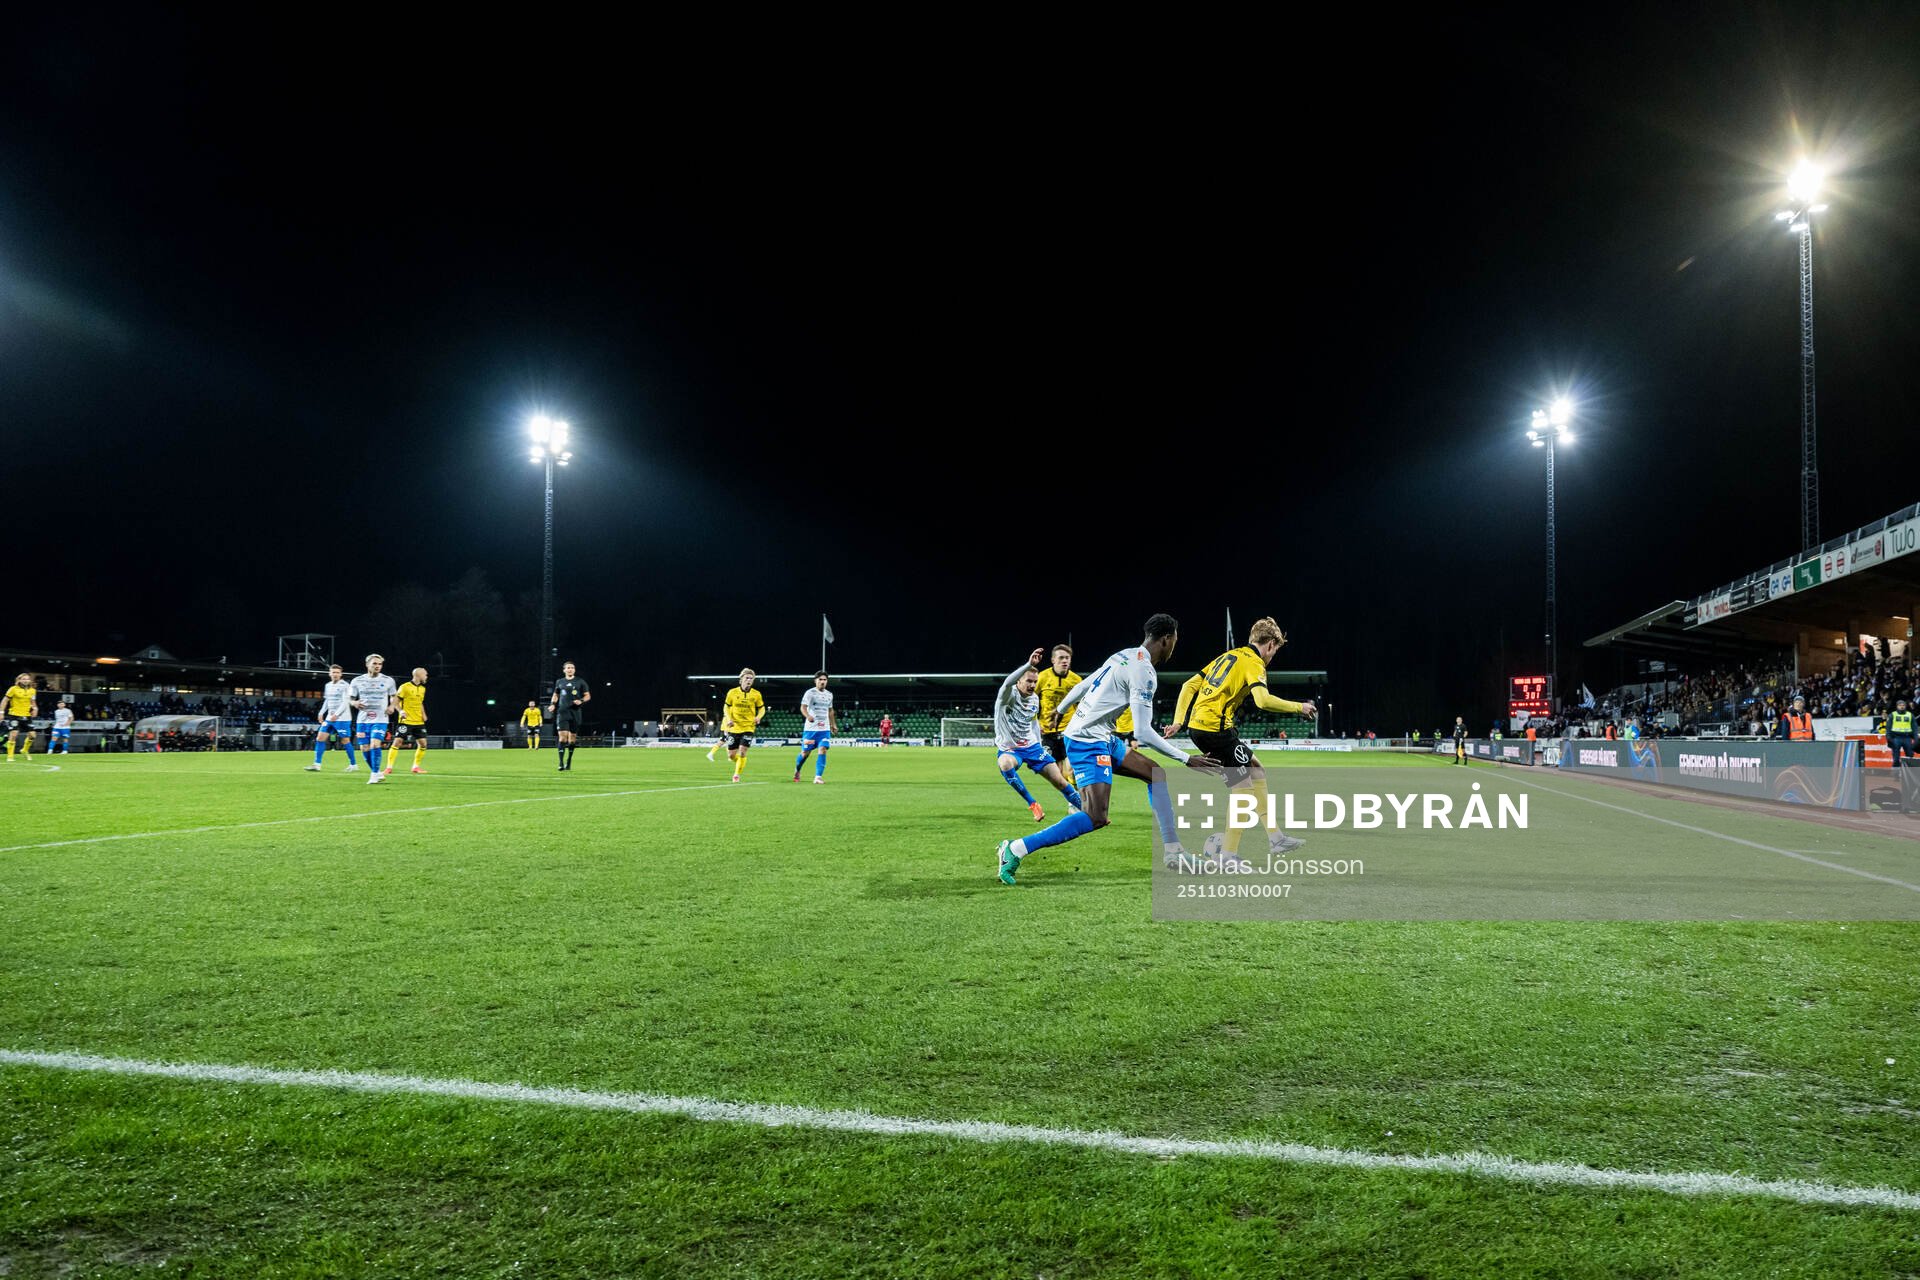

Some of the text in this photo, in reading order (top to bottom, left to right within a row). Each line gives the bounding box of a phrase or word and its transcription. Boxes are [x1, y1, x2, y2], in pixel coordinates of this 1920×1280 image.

[1091, 665, 1112, 693] 4
[1206, 654, 1238, 688] 10
[1104, 767, 1109, 776] 4
